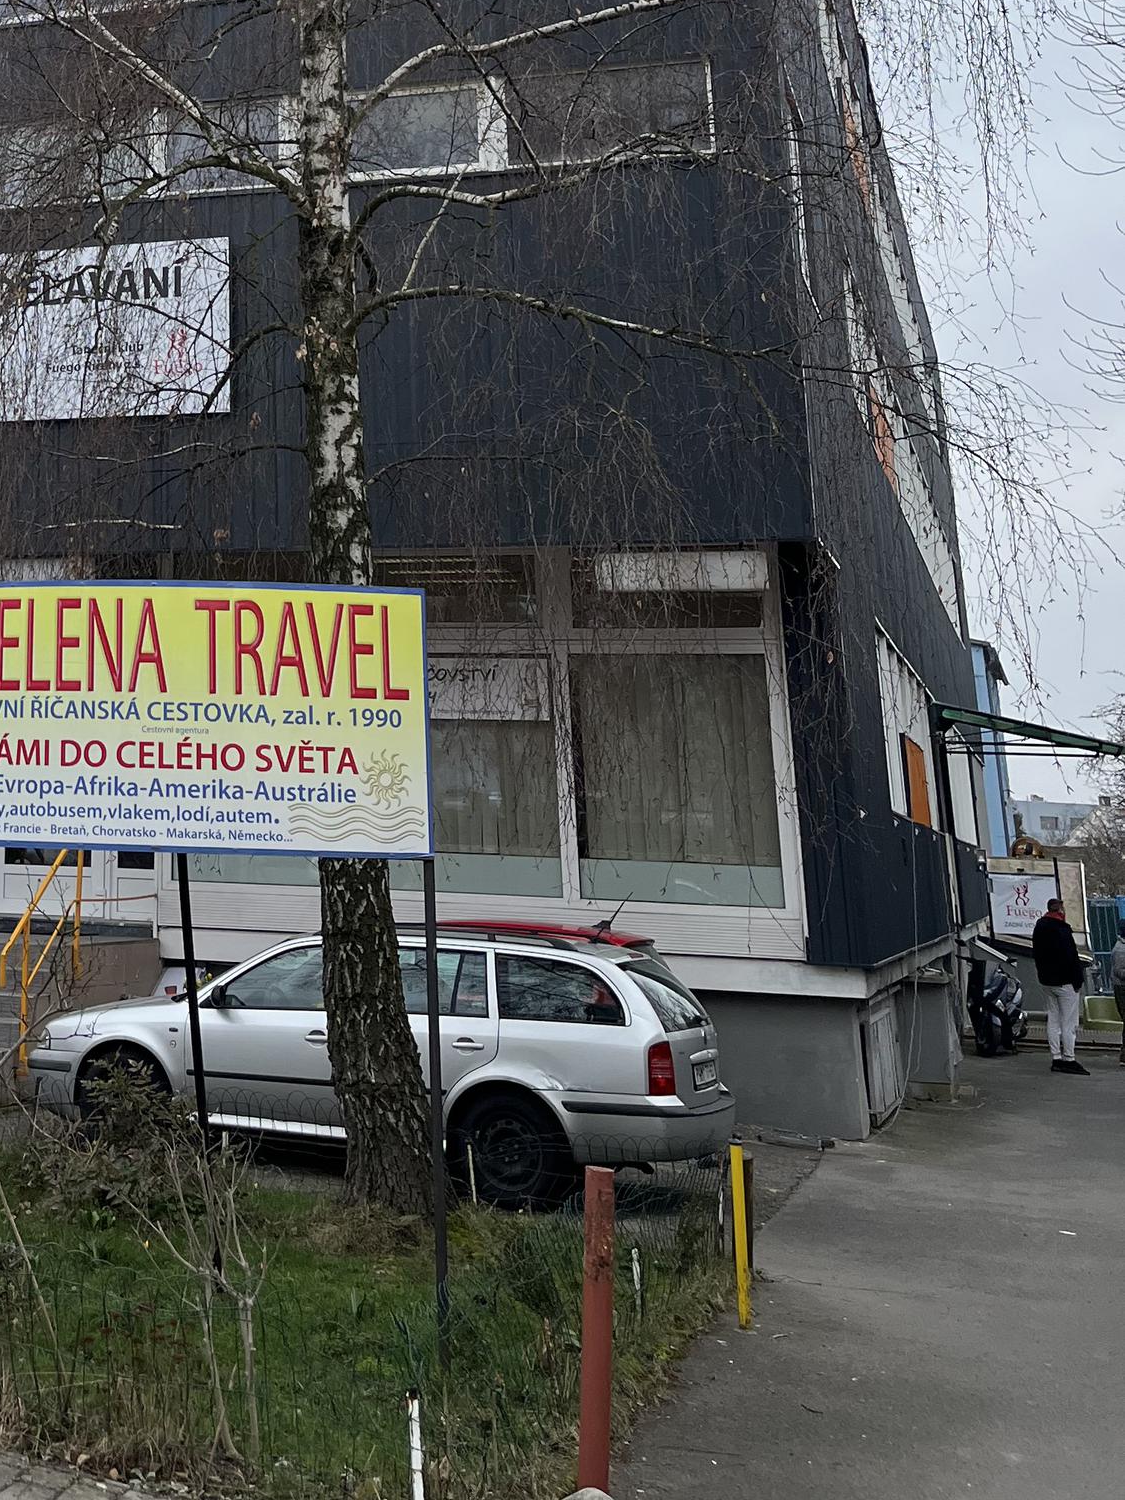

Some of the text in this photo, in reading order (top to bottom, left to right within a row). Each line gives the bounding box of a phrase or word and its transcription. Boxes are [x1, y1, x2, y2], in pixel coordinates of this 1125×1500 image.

[44, 360, 82, 376] Fuego
[194, 599, 410, 701] TRAVEL
[30, 695, 141, 721] ŘÍČANSKÁ
[147, 701, 276, 727] CESTOVKA,
[282, 704, 320, 726] zal.
[327, 711, 342, 726] r.
[349, 708, 402, 728] 1990
[141, 724, 210, 736] Cestovní agentura
[60, 739, 107, 768] DO
[116, 736, 245, 772] CELÉHO
[255, 739, 359, 775] SVĚTA
[3, 822, 42, 834] Francie
[50, 823, 90, 837] Bretaň,
[92, 825, 157, 838] Chorvatsko
[166, 827, 225, 842] Makarská,
[228, 829, 295, 842] Německo...
